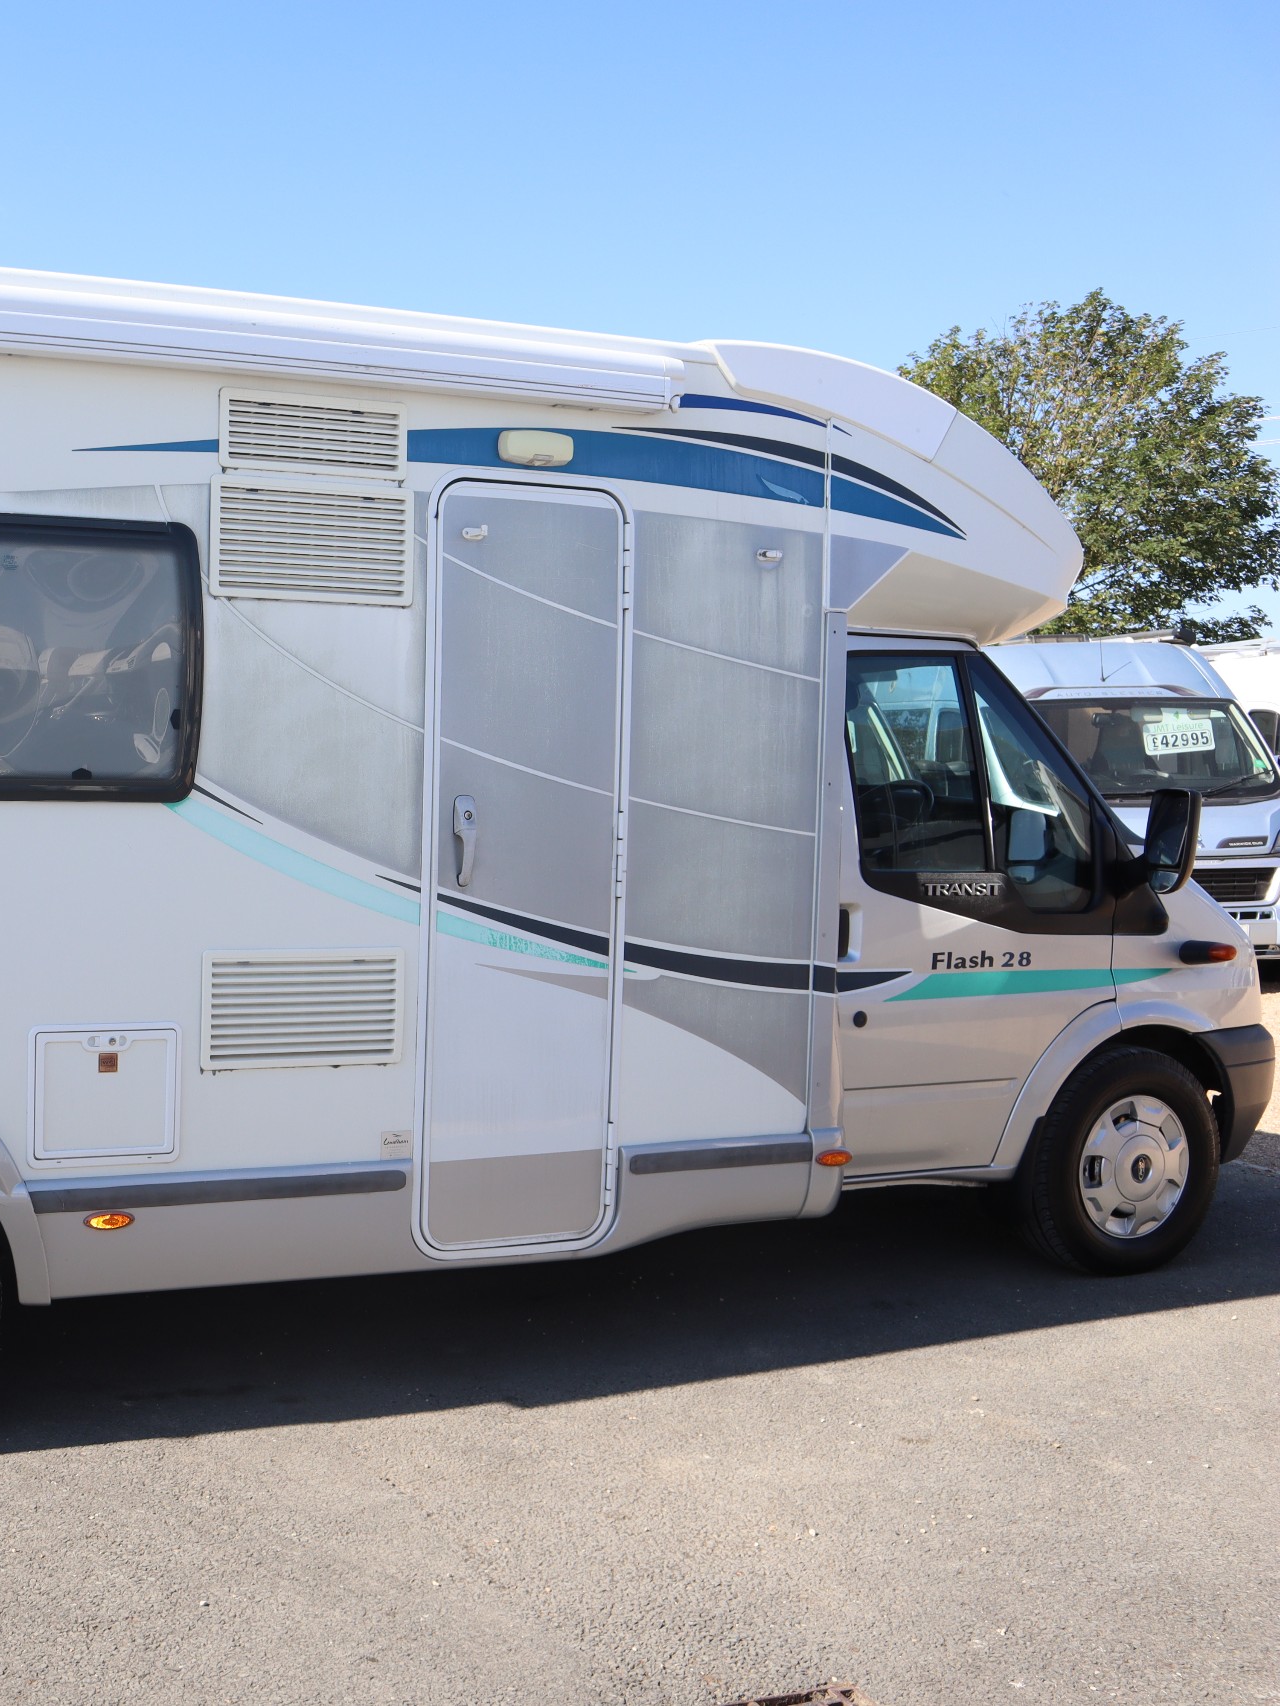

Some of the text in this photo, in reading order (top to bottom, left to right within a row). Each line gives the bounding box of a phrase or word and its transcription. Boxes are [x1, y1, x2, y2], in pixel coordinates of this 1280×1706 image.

[1172, 721, 1204, 732] Leisure
[1152, 731, 1209, 748] £42995
[924, 882, 1001, 896] TRANSIT
[931, 950, 1032, 970] Flash 28
